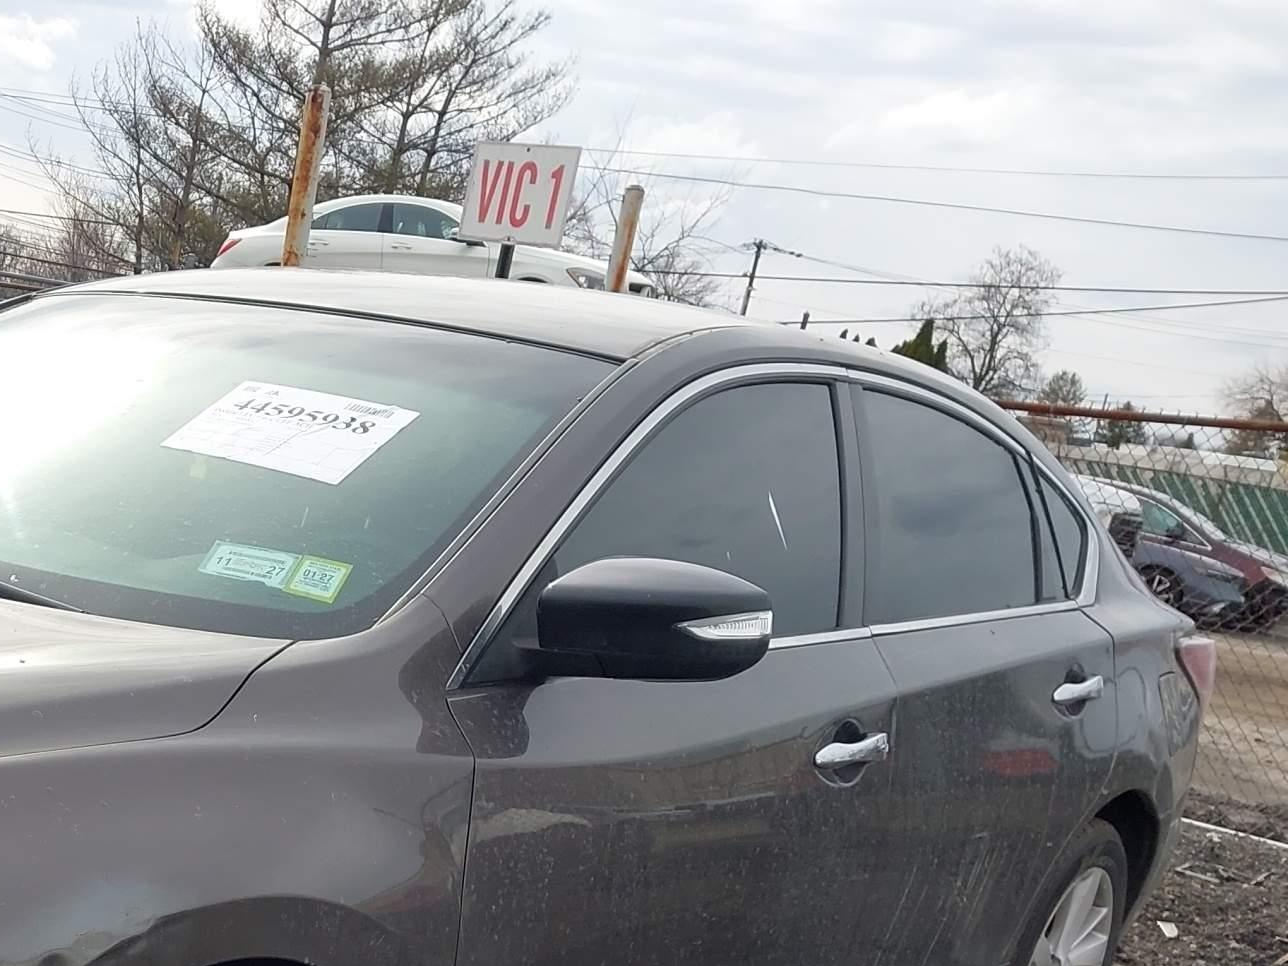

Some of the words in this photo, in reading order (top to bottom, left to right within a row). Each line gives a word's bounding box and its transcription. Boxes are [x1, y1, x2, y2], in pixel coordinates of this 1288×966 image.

[478, 160, 538, 228] VIC
[545, 165, 565, 230] 1
[233, 398, 377, 435] 44595938
[216, 556, 233, 567] 11
[265, 565, 286, 577] 27
